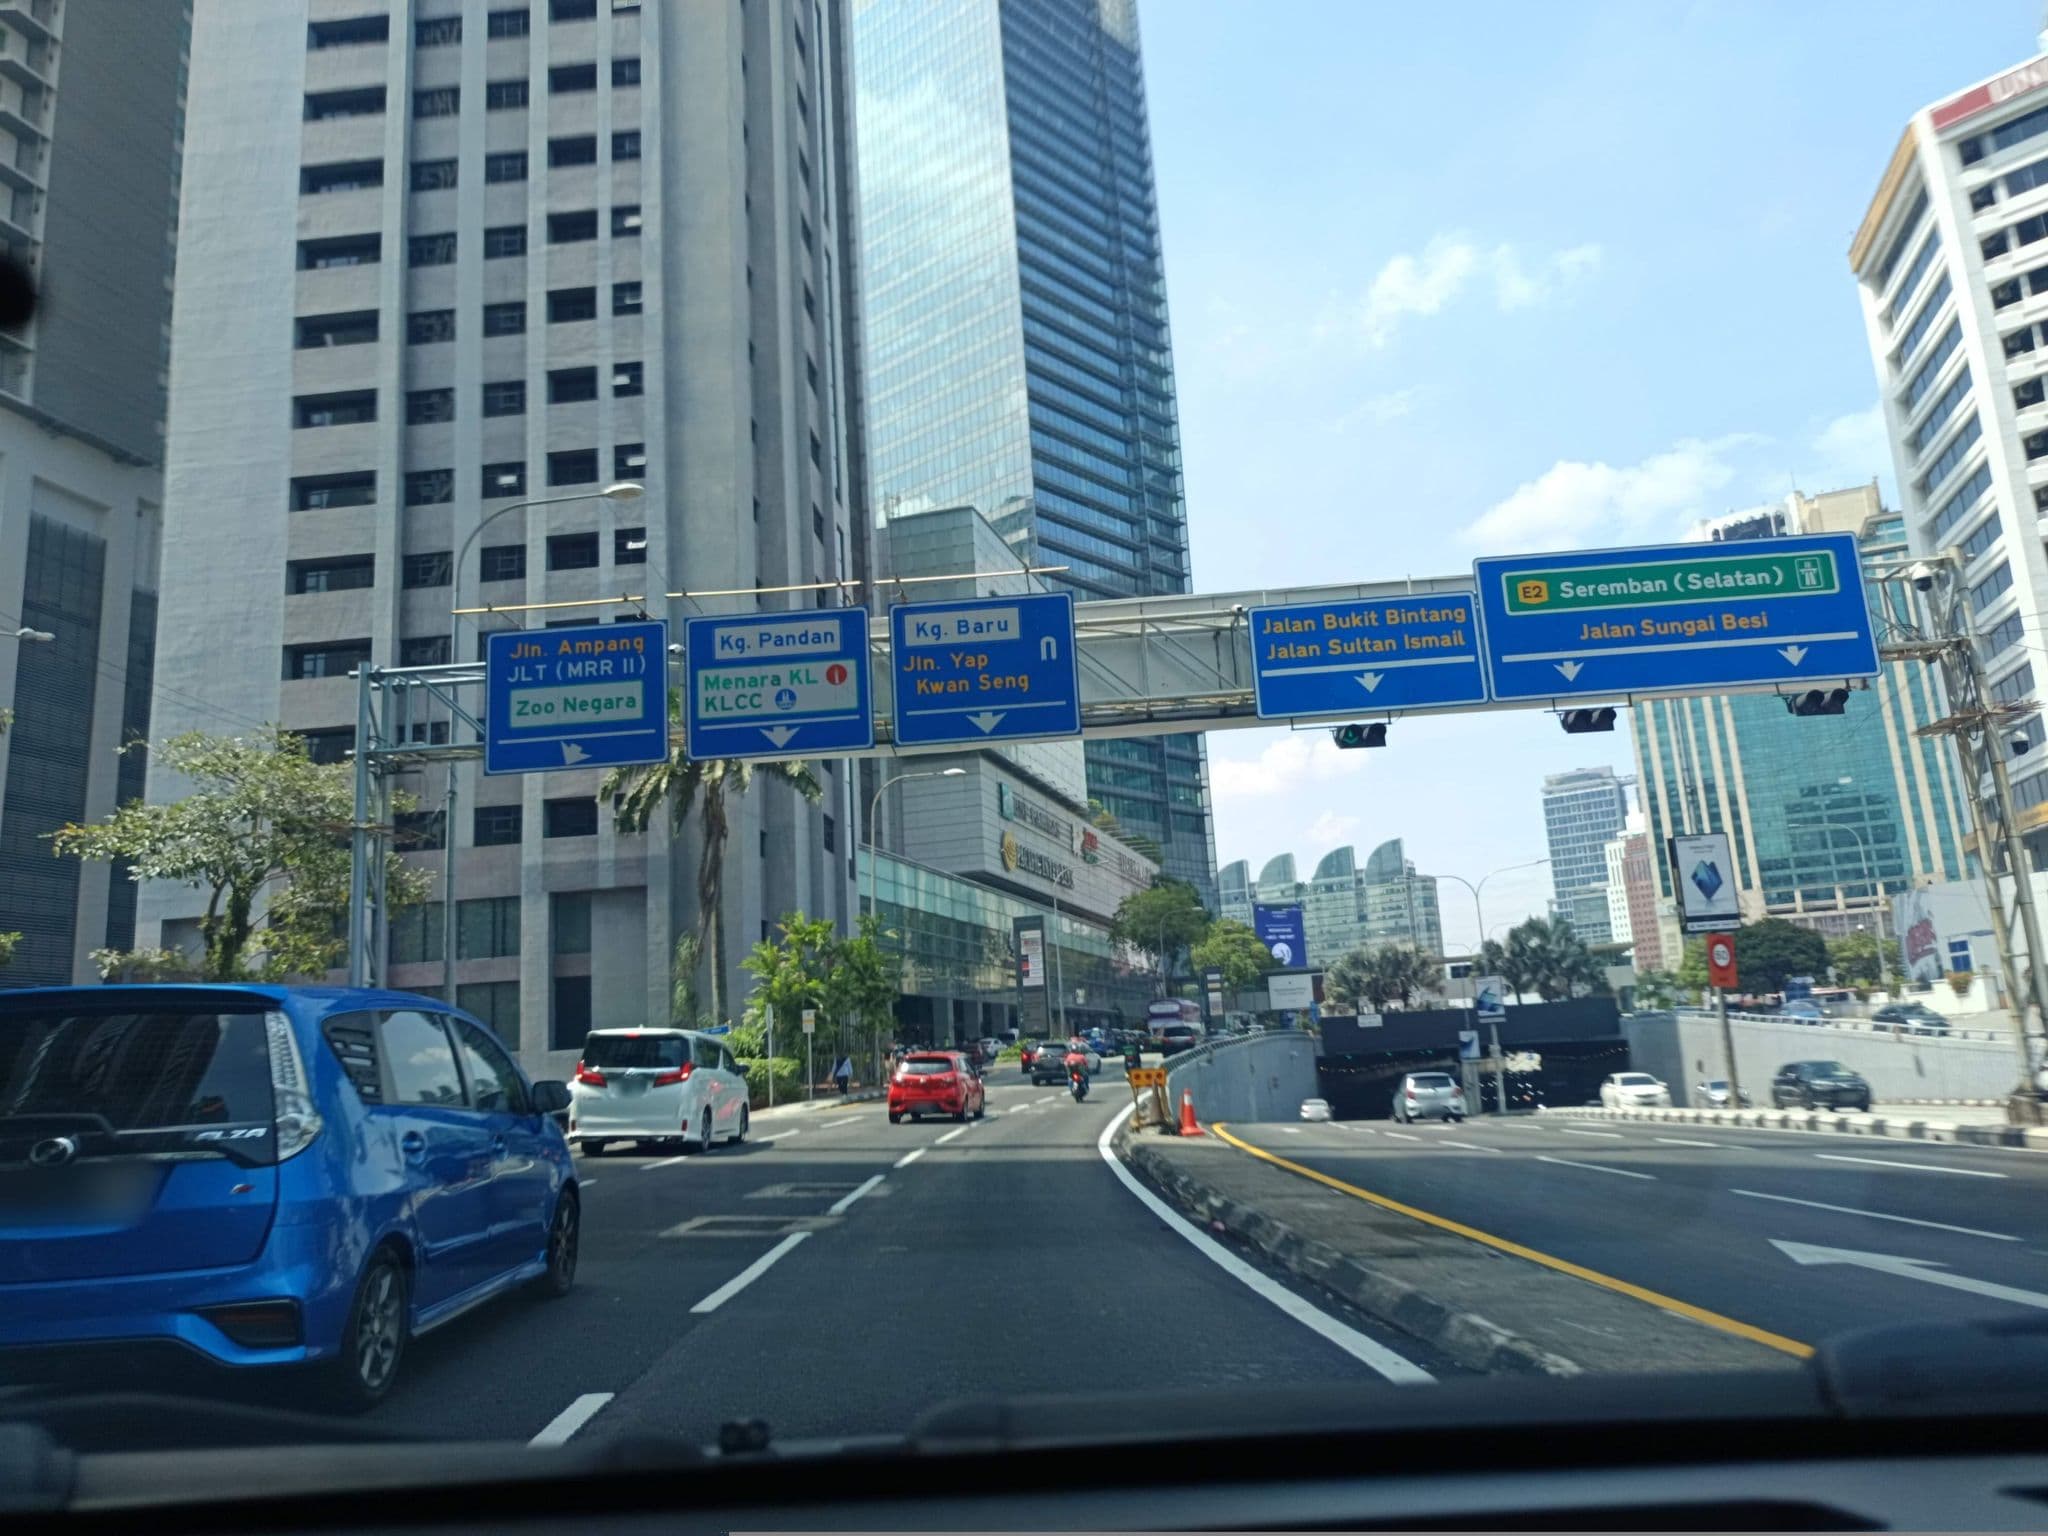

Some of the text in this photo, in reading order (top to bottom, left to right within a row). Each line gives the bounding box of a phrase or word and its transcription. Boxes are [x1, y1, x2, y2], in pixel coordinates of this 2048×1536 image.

[1522, 565, 1784, 599] E2 Seremban (Selatan)
[915, 618, 1009, 641] Kg. Baru
[1263, 607, 1467, 634] Jalan Bukit Bintang
[1579, 610, 1769, 641] Jalan Sungai Besi
[510, 637, 644, 659] Jln. Ampang
[720, 630, 835, 654] Kg. Pandan
[1267, 630, 1466, 660] Jalan Sultan Ismail
[507, 665, 547, 682] JLT
[556, 660, 613, 680] (MRR
[903, 652, 989, 672] Jln. Yap
[704, 668, 818, 692] Menara KL
[916, 674, 1030, 695] Kwan Seng
[516, 696, 637, 716] Zoo Negara
[705, 693, 763, 712] KLCC
